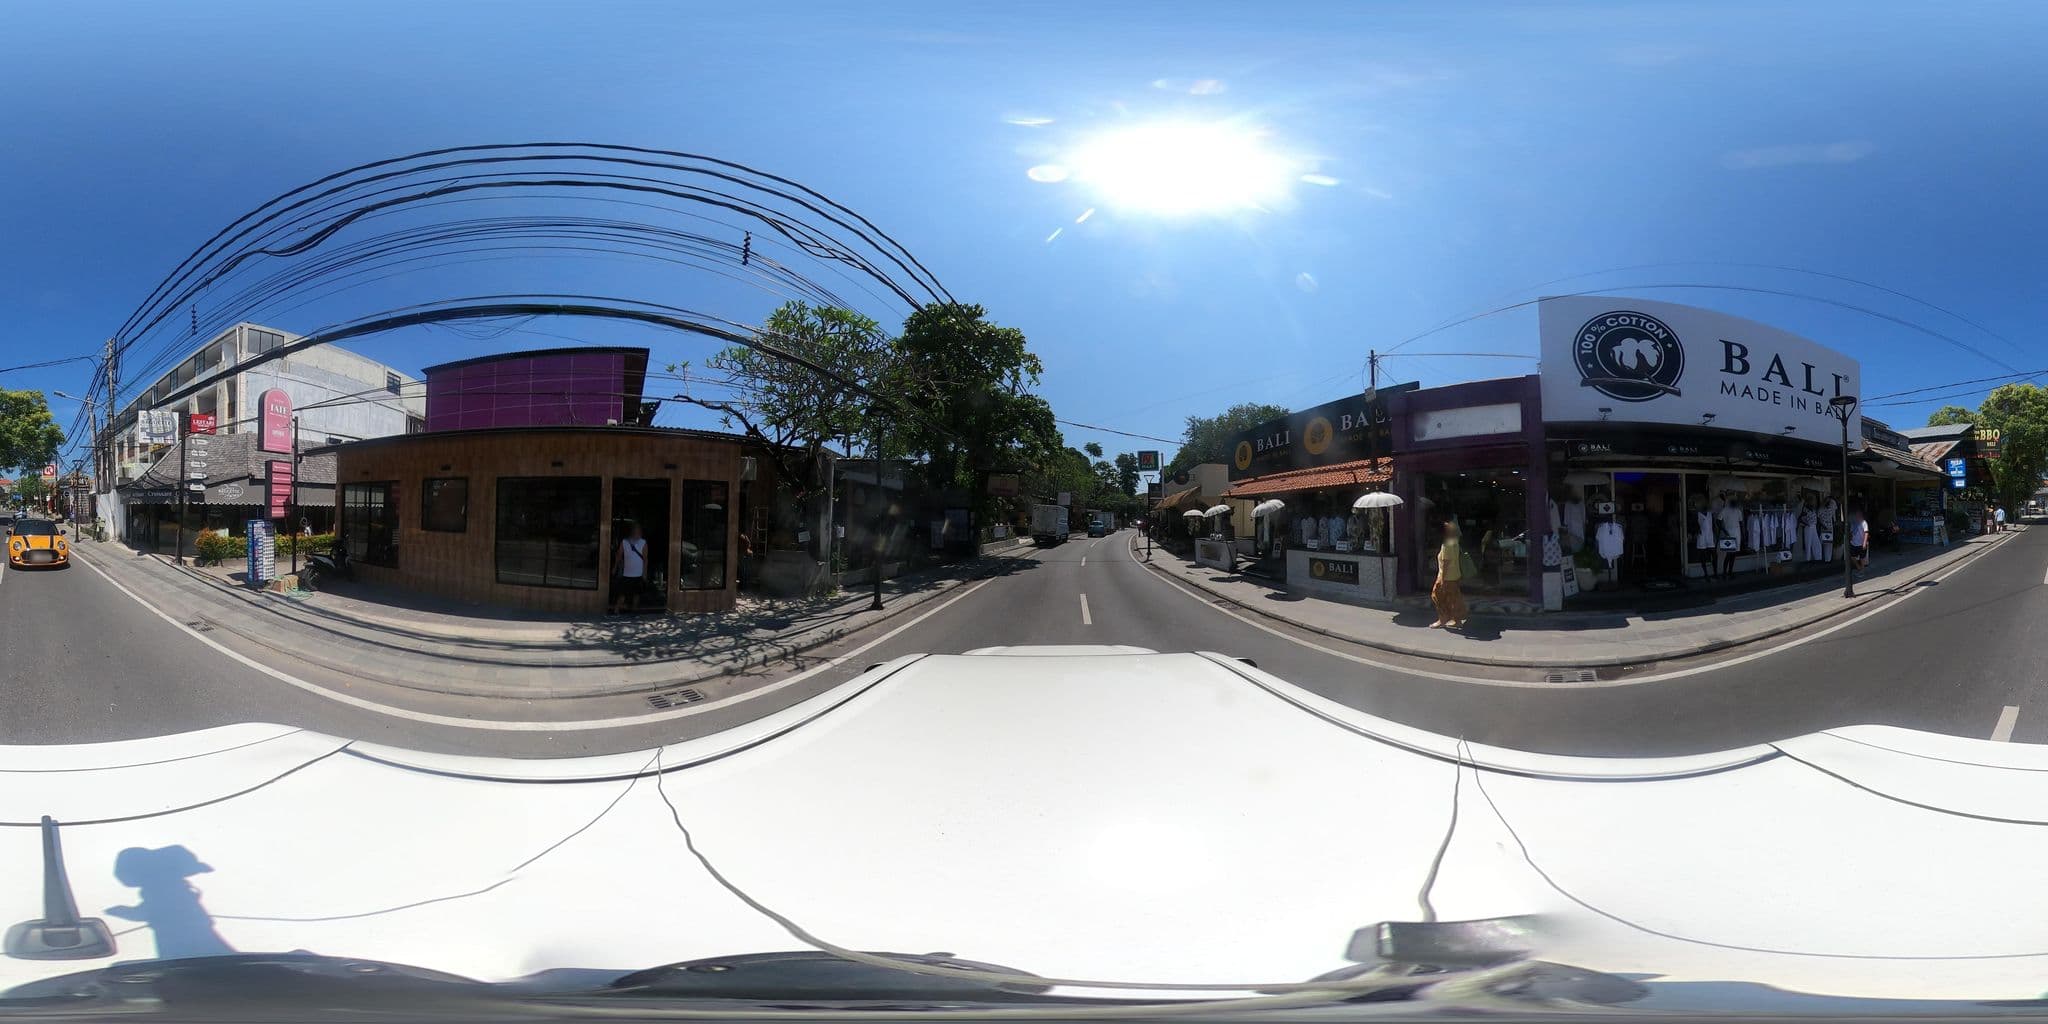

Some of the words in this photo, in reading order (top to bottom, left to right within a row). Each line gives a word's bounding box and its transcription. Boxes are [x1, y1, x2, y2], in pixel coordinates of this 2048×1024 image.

[1606, 316, 1668, 339] COTTON
[1720, 380, 1781, 405] MADE
[1790, 395, 1807, 411] IN
[1815, 402, 1842, 420] BAL
[1340, 409, 1393, 431] BAL
[1256, 430, 1291, 452] BALI
[1980, 428, 2000, 441] BBQ
[1329, 562, 1353, 574] BALI
